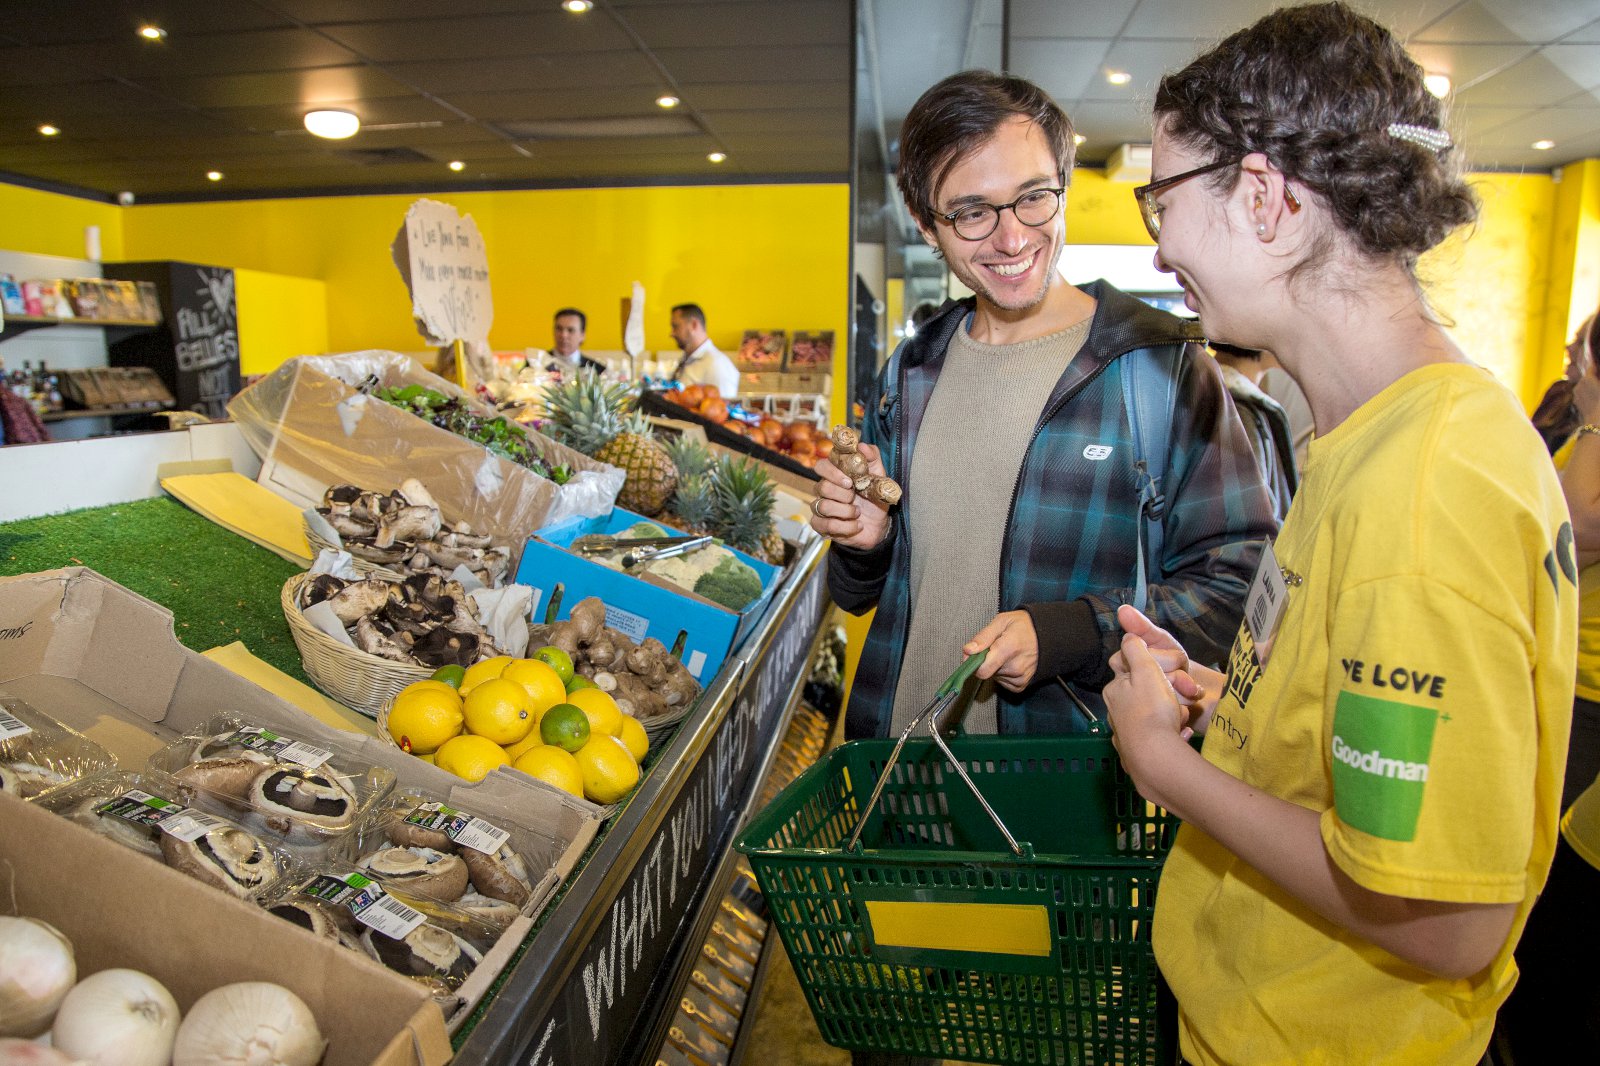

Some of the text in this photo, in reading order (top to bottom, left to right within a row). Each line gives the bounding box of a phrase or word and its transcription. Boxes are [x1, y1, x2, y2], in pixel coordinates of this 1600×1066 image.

[1372, 663, 1447, 699] LOVE
[1332, 735, 1429, 782] Goodman
[582, 830, 665, 1042] WHAT
[670, 775, 706, 910] YOU
